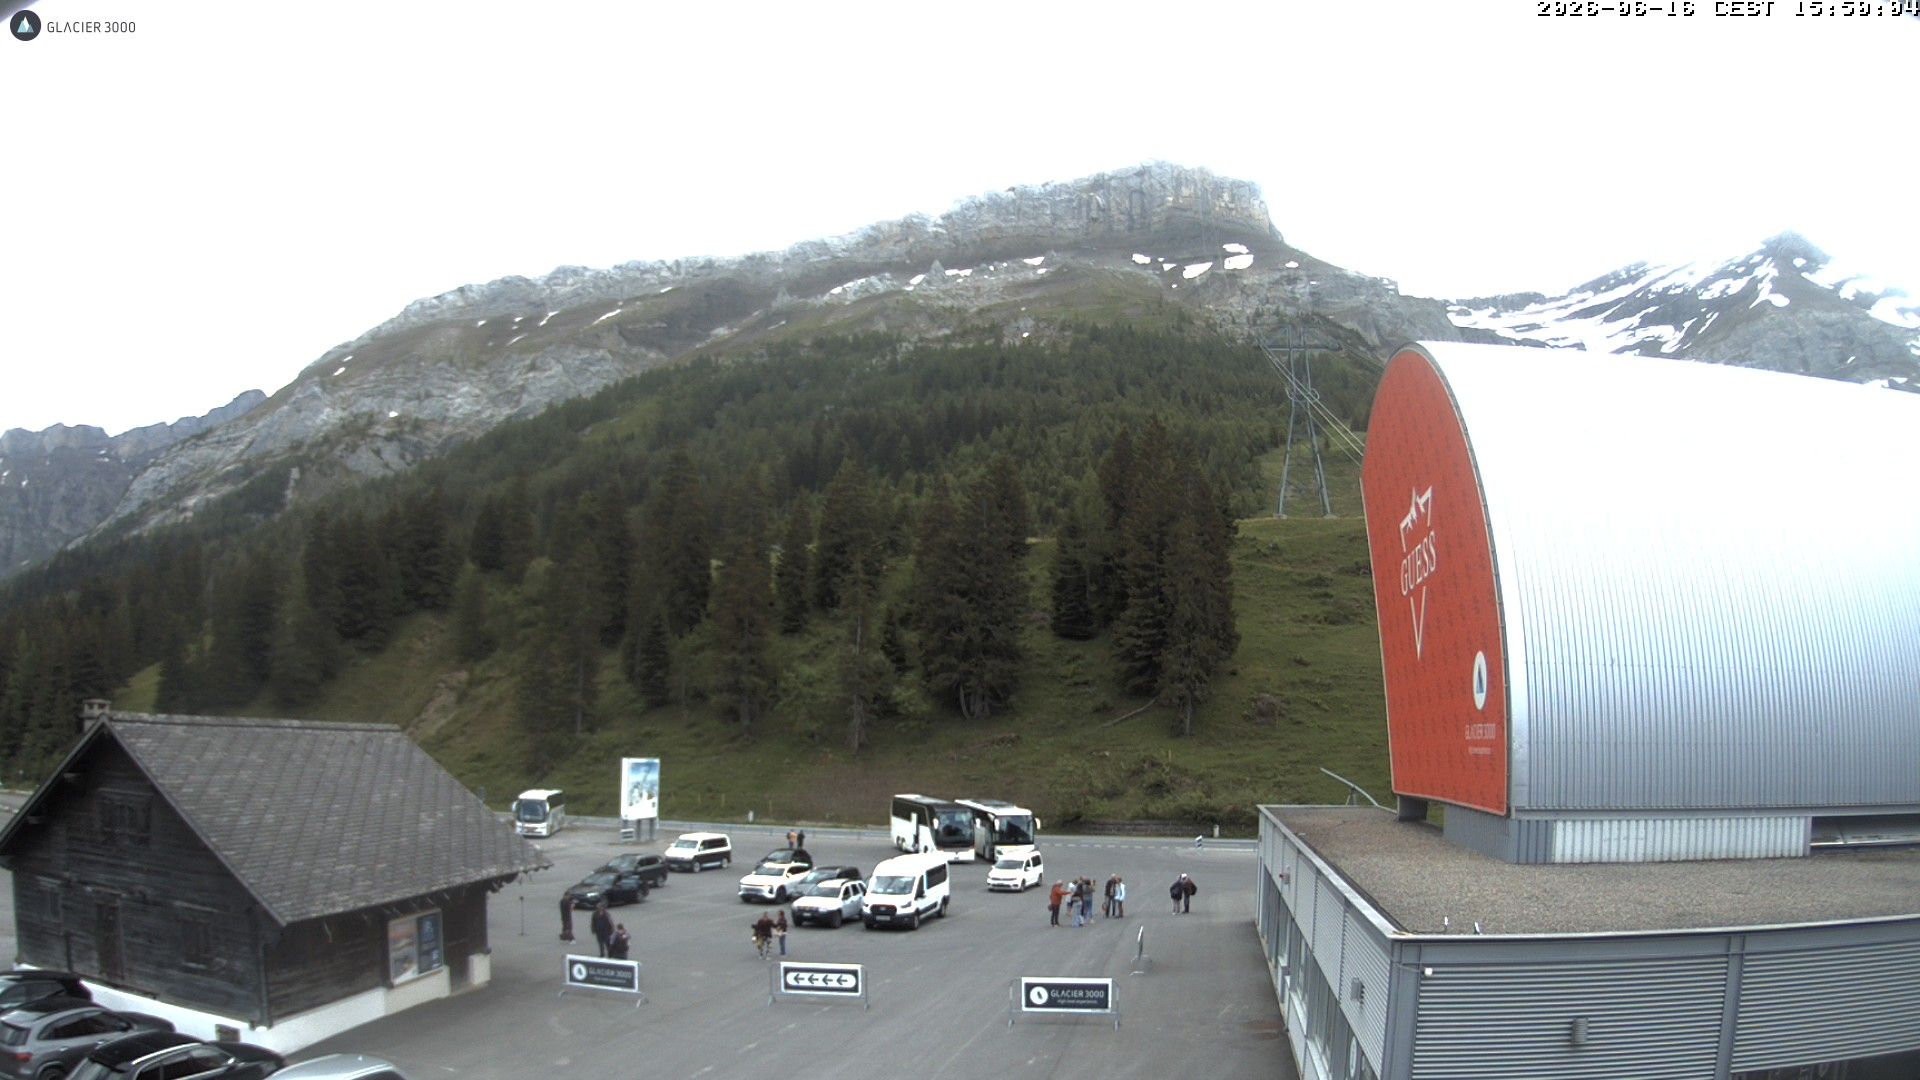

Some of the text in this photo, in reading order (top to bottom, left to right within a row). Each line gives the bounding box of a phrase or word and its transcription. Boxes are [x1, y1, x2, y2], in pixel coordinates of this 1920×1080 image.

[1400, 531, 1436, 596] GUESS
[1050, 989, 1105, 999] GLACIER 3000
